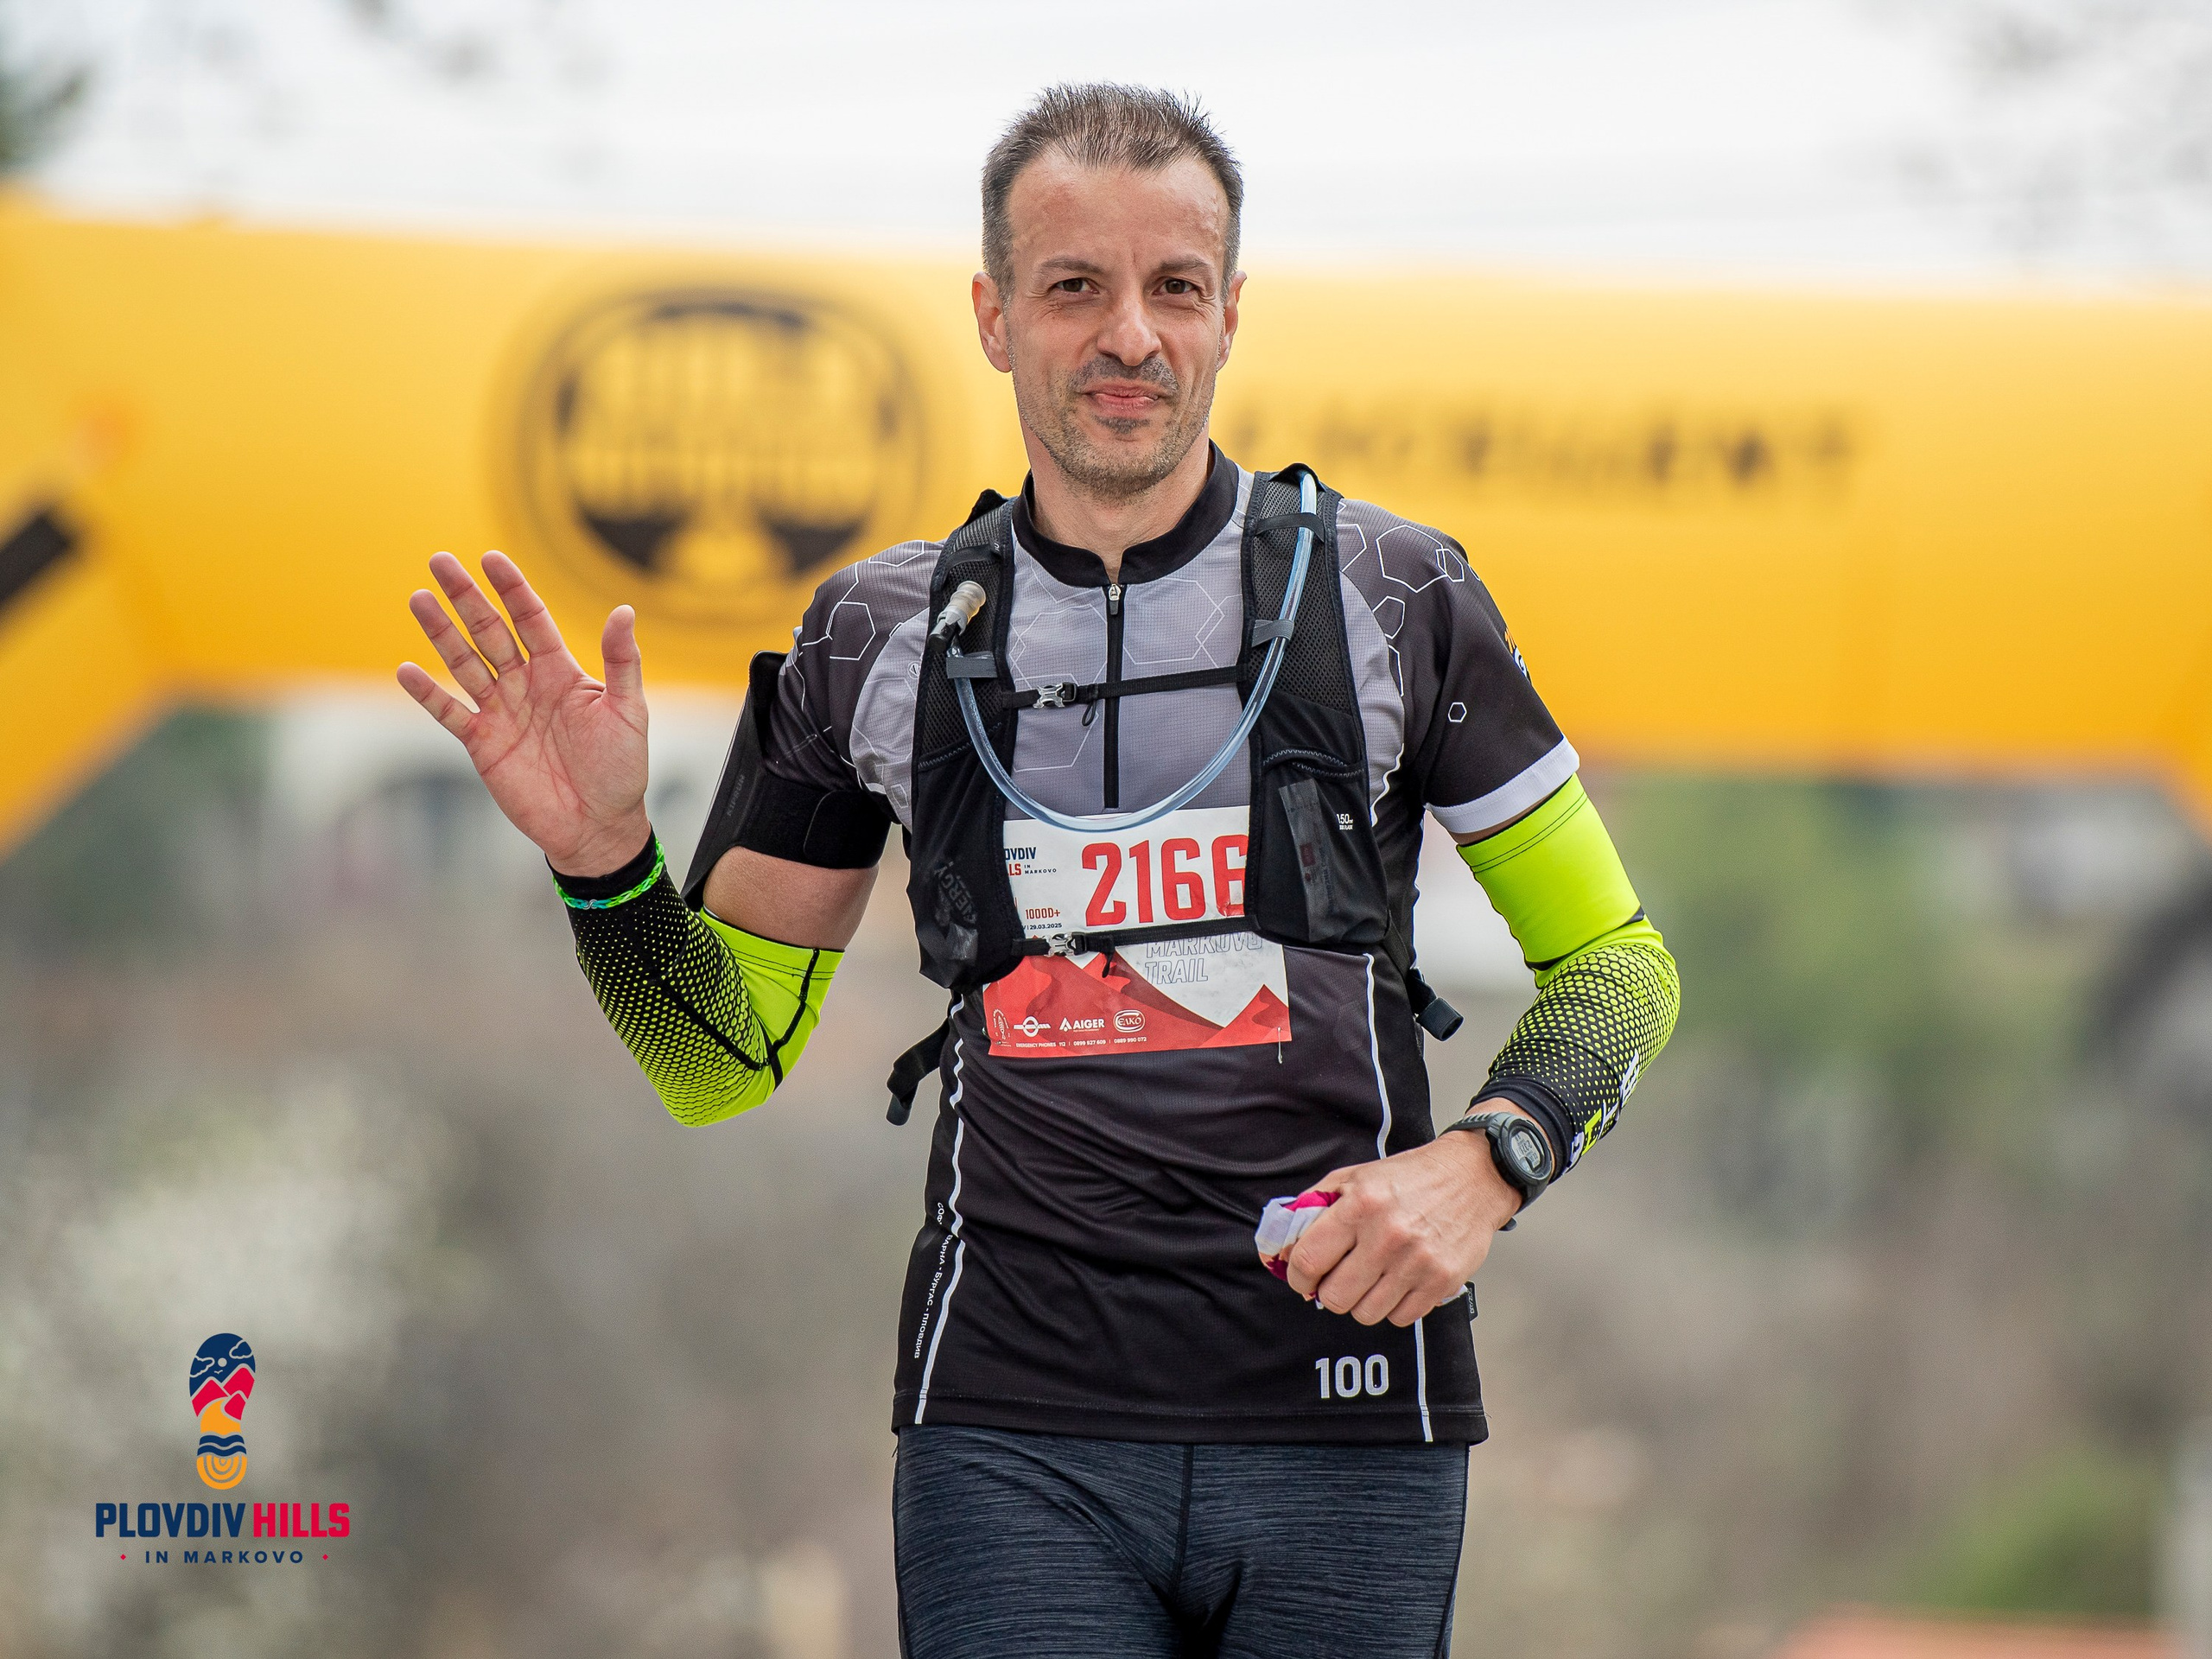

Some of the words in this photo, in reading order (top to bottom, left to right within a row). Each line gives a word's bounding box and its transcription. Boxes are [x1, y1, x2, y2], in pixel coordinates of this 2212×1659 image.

[1004, 847, 1037, 861] OVDIV
[1082, 834, 1249, 926] 2166
[1145, 958, 1209, 985] TRAIL
[1073, 1018, 1105, 1030] AIGER
[937, 1202, 945, 1224] СОФ
[939, 1235, 953, 1265] ВАРНА
[927, 1272, 943, 1306] БУРГАС
[914, 1313, 930, 1358] ПЛОВДИВ
[1315, 1353, 1389, 1399] 100
